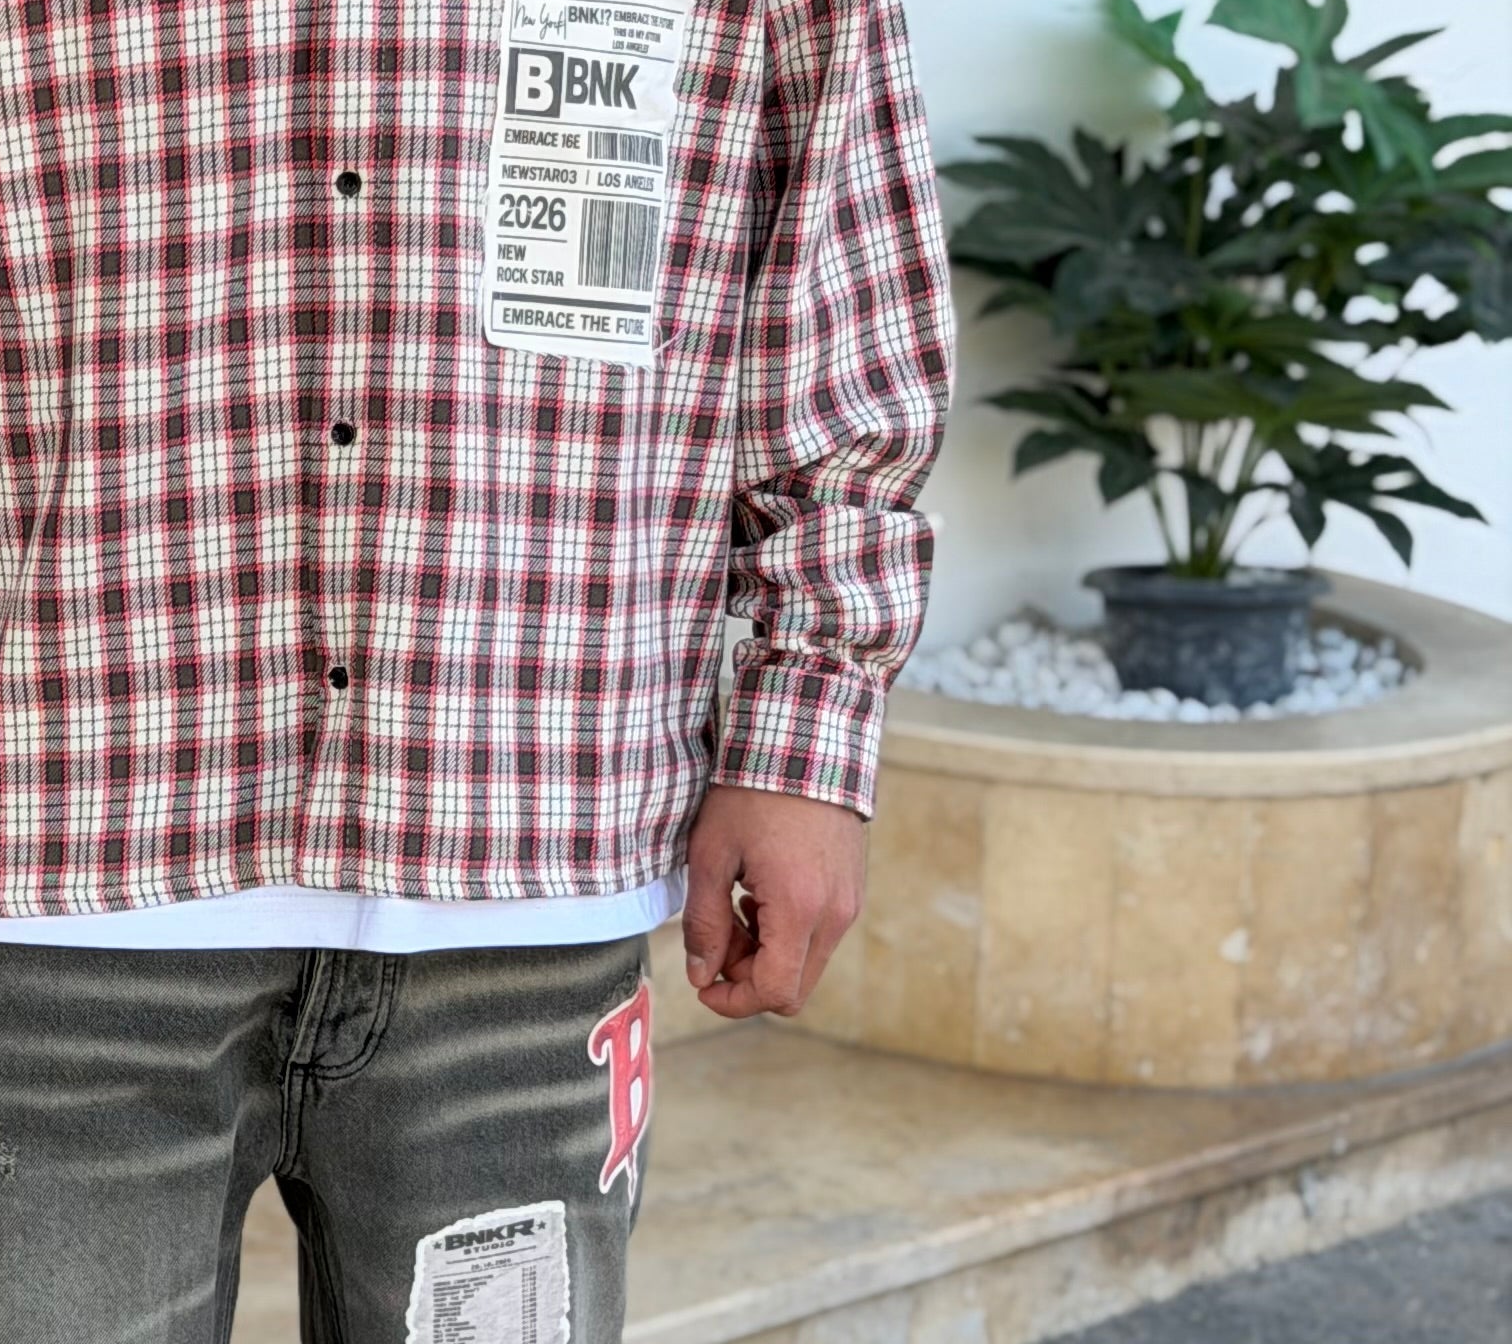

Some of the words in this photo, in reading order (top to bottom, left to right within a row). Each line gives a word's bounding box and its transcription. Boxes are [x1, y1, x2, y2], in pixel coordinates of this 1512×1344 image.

[613, 10, 650, 25] EMBRACE
[515, 51, 554, 112] B
[565, 56, 640, 110] BNK
[504, 128, 559, 147] EMBRACE
[597, 172, 621, 188] LOS
[498, 193, 566, 232] 2026
[497, 243, 527, 261] NEW
[496, 266, 528, 285] ROCK
[531, 270, 564, 287] STAR
[502, 307, 575, 330] EMBRACE
[580, 314, 611, 333] THE
[444, 1218, 535, 1251] BNKR
[463, 1239, 515, 1255] STUDIO
